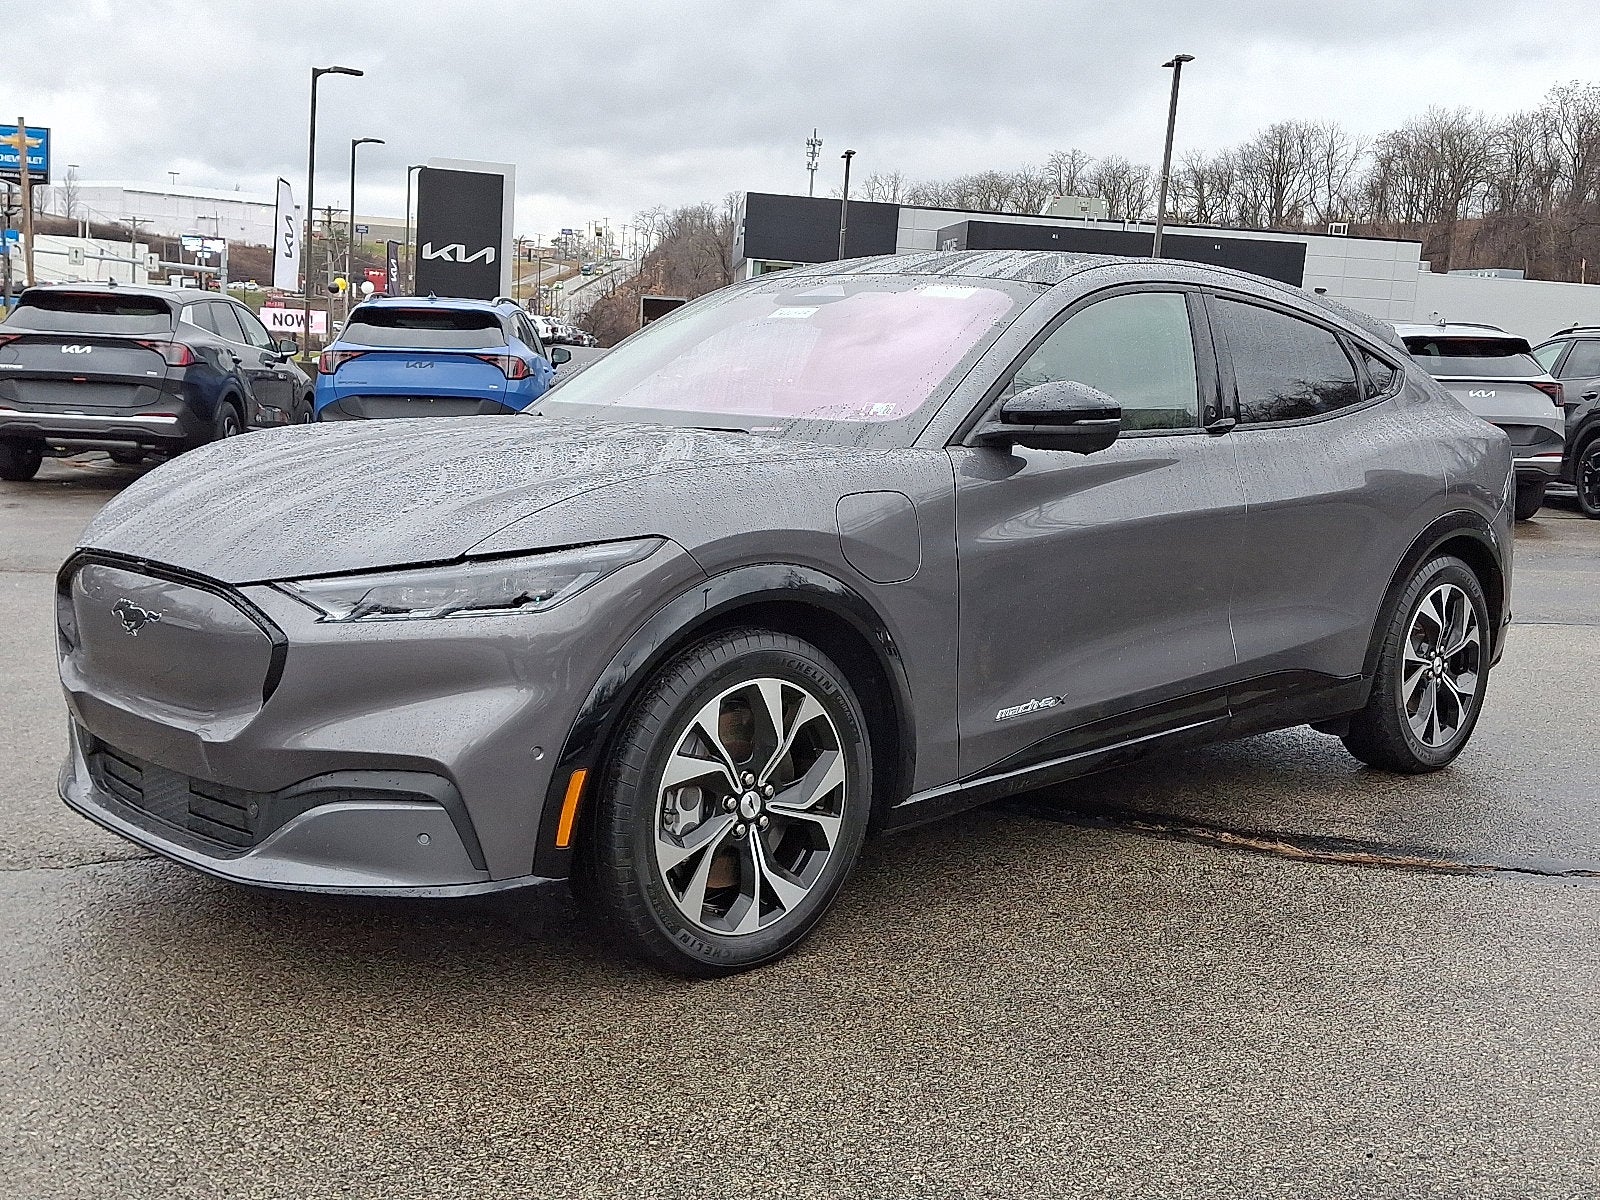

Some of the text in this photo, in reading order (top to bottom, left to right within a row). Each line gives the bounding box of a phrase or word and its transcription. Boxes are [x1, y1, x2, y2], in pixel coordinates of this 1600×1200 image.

[422, 241, 496, 265] KIA
[272, 312, 314, 328] NOW!
[61, 344, 92, 354] KIA
[406, 360, 435, 369] KIA
[1469, 389, 1496, 398] KIA
